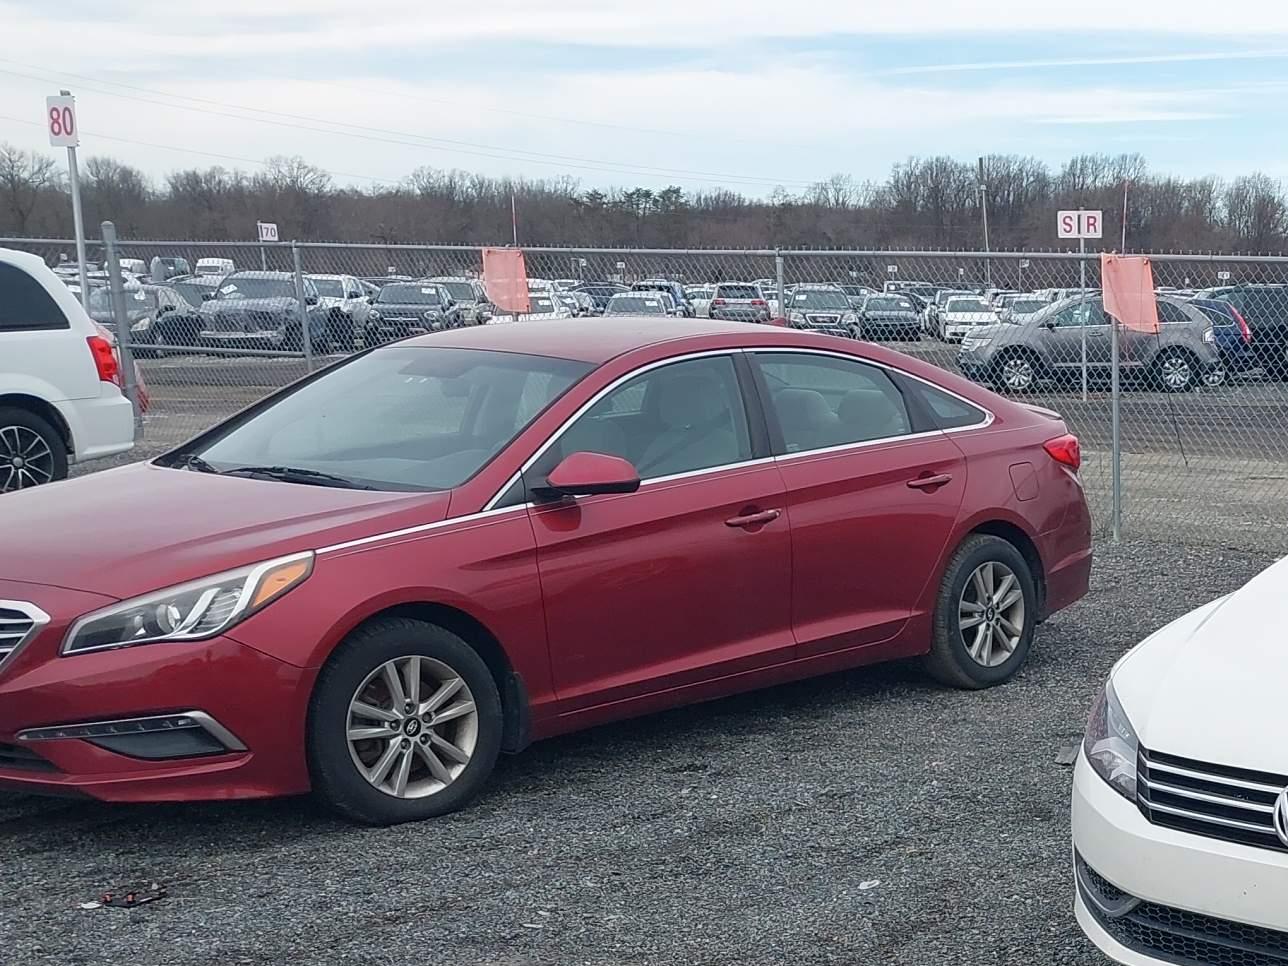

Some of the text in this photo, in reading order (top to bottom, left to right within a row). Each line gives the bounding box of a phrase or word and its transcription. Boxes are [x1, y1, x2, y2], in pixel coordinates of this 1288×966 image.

[50, 106, 74, 136] 80
[263, 226, 277, 238] 70
[1062, 215, 1097, 234] S R
